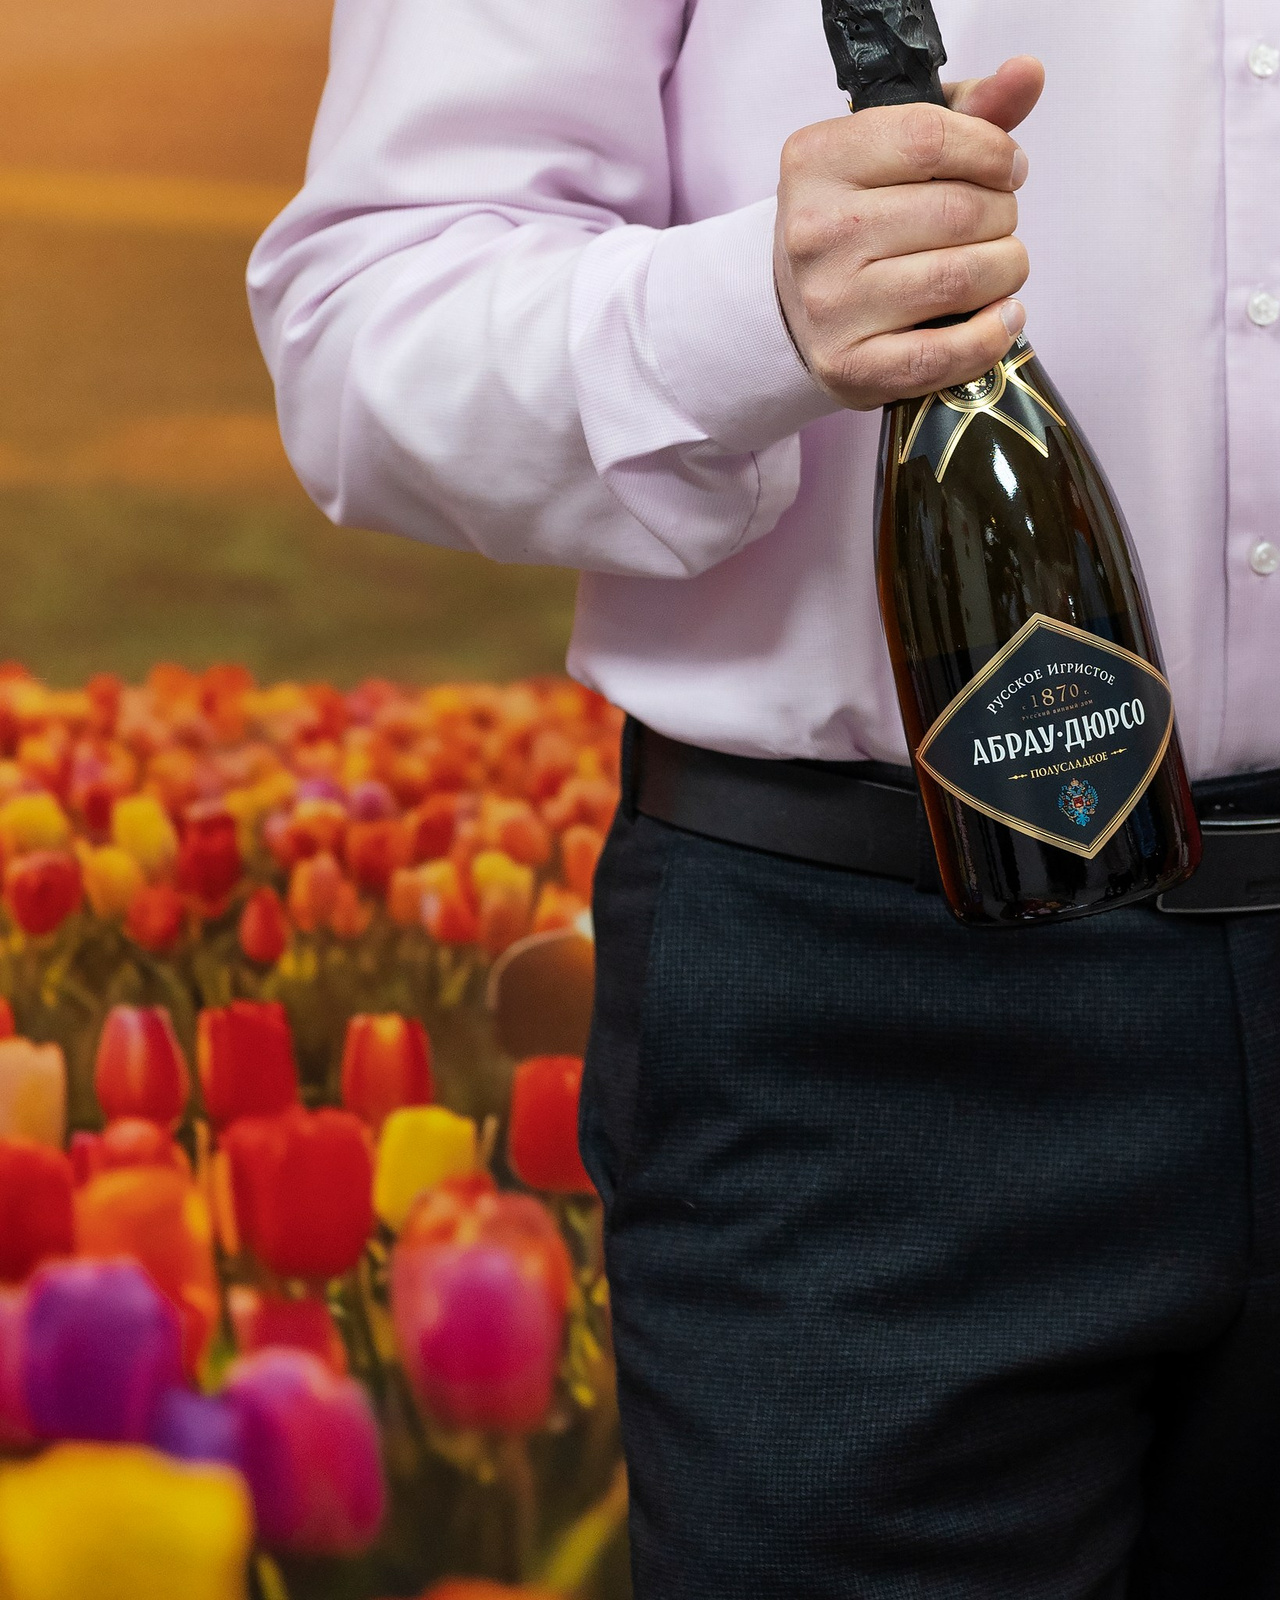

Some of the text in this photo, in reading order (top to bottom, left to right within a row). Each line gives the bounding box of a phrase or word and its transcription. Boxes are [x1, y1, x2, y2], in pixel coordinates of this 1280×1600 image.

[986, 668, 1043, 715] РУССКОЕ
[1030, 683, 1079, 709] 1870
[1030, 751, 1109, 779] ПОЛУСЛАДКОЕ
